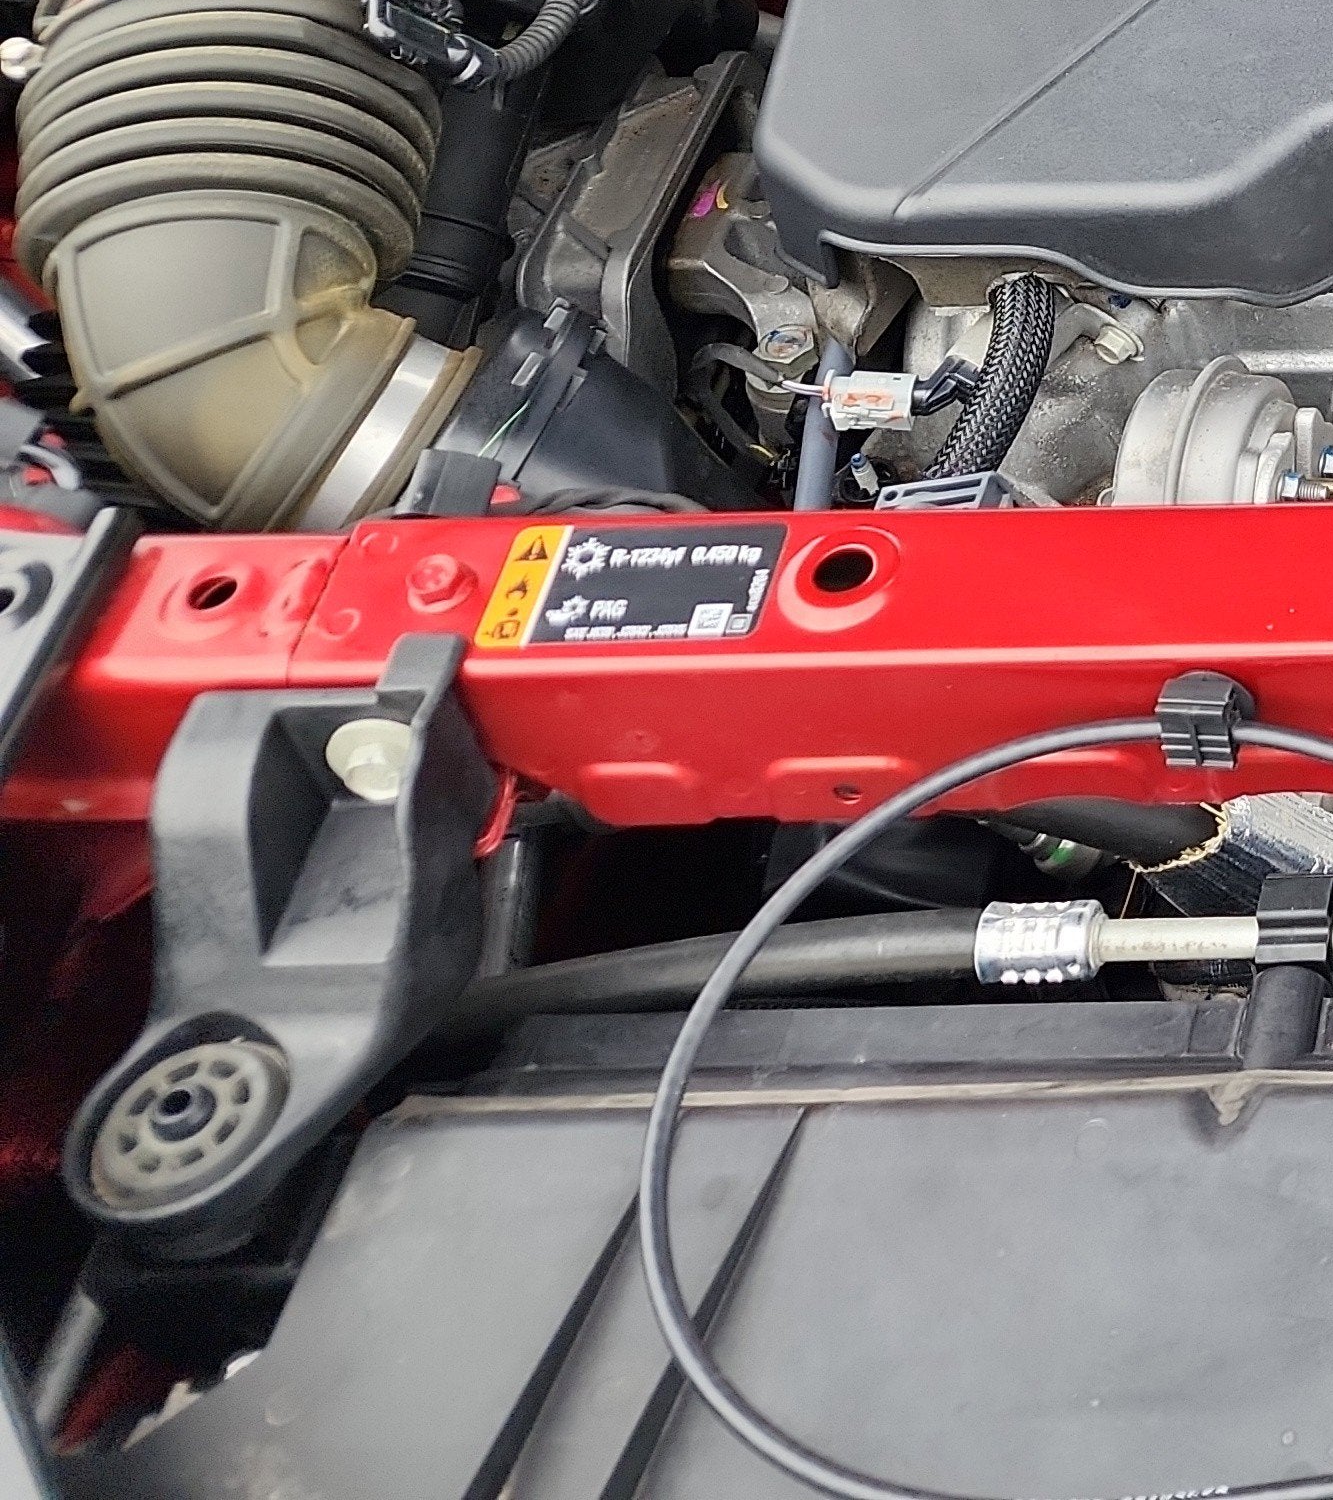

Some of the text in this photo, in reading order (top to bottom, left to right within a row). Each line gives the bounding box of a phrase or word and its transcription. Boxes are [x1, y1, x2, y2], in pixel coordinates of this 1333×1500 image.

[609, 546, 687, 568] R-1234yf
[739, 545, 763, 566] kg
[589, 599, 628, 620] PAG
